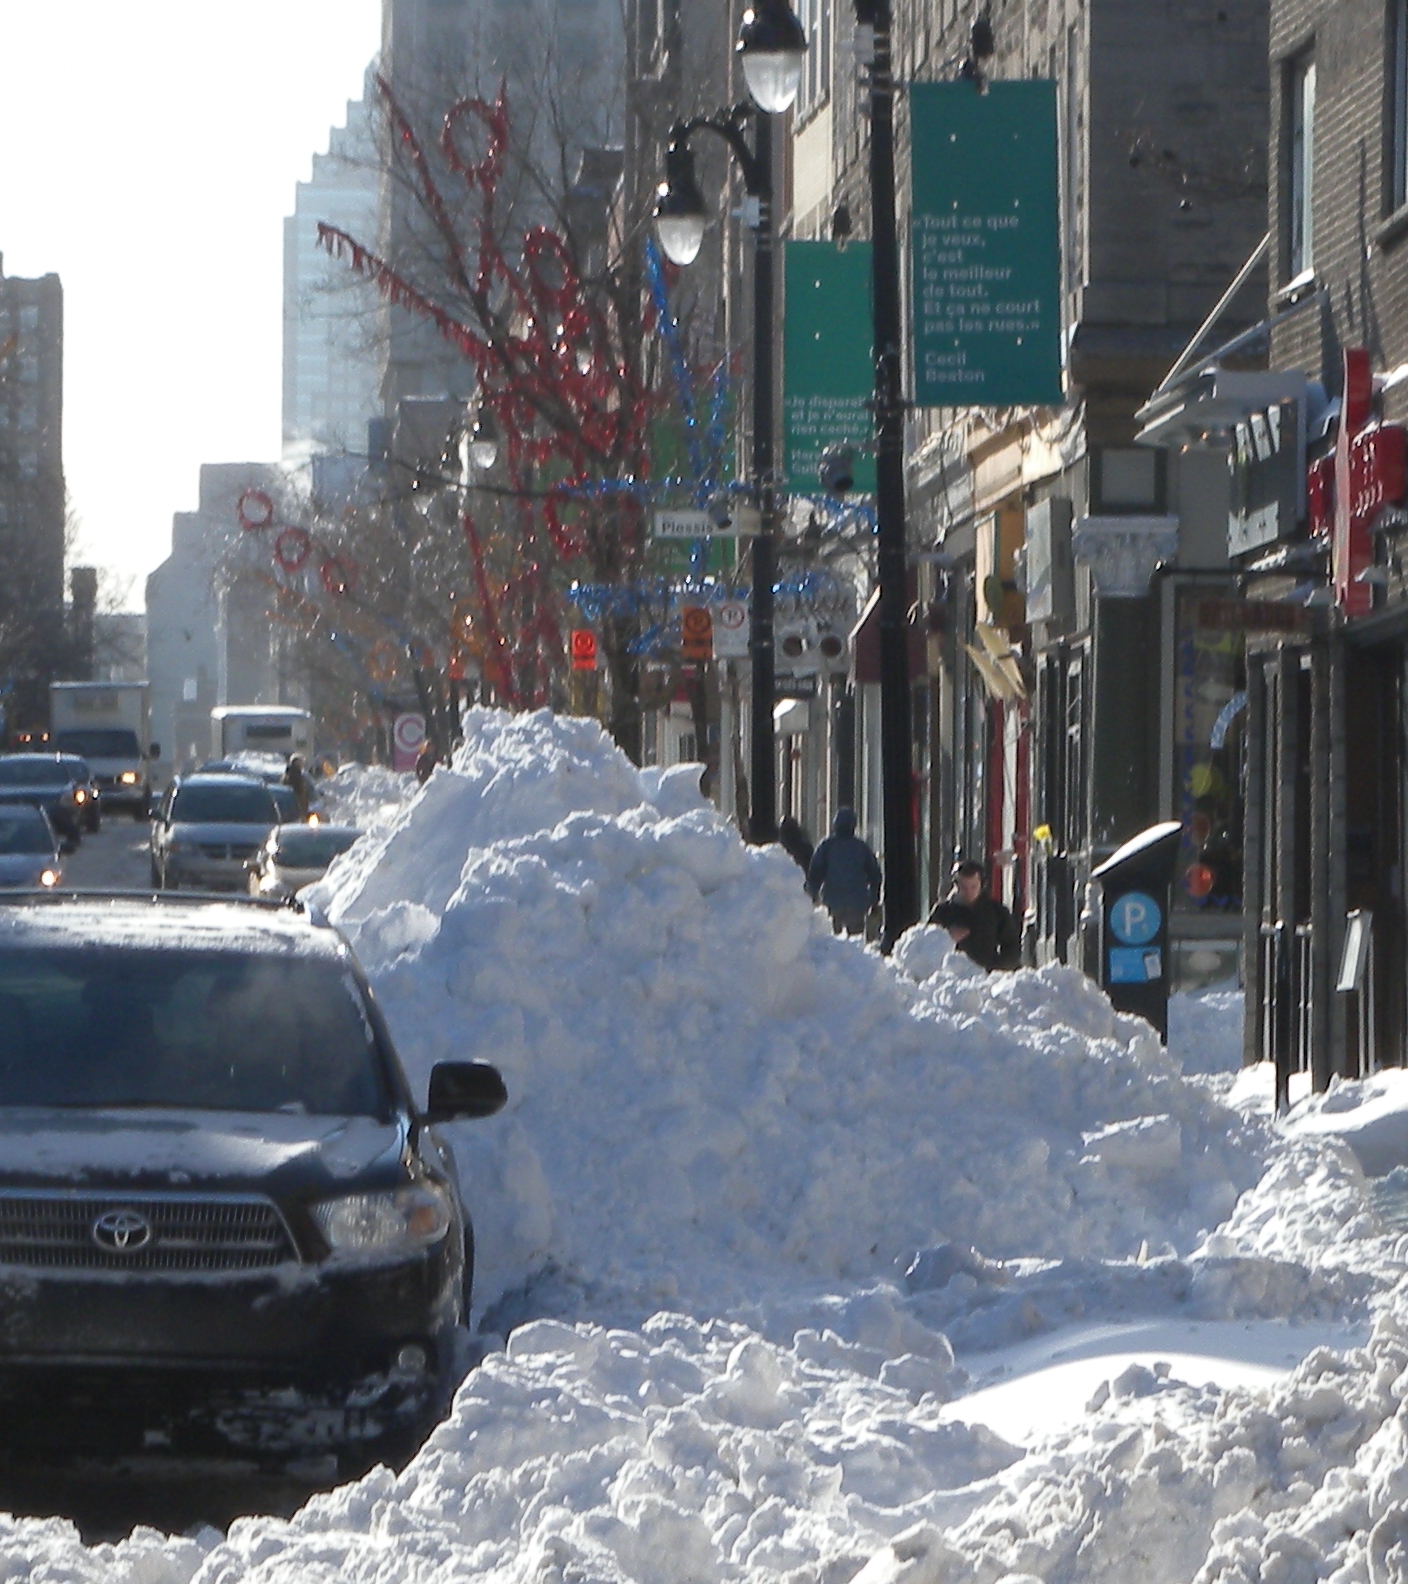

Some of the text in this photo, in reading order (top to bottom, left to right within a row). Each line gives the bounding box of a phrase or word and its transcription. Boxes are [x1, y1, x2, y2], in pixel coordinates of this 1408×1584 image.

[961, 216, 983, 229] ce
[986, 215, 1020, 231] que
[922, 232, 938, 250] je
[922, 265, 1012, 281] le meilleur
[922, 282, 989, 299] de tout.
[923, 300, 942, 315] Et
[970, 304, 991, 316] ne
[995, 299, 1041, 315] court
[924, 320, 955, 336] pas
[959, 317, 984, 332] les
[925, 350, 968, 366] Cecil
[925, 367, 986, 383] Beaton
